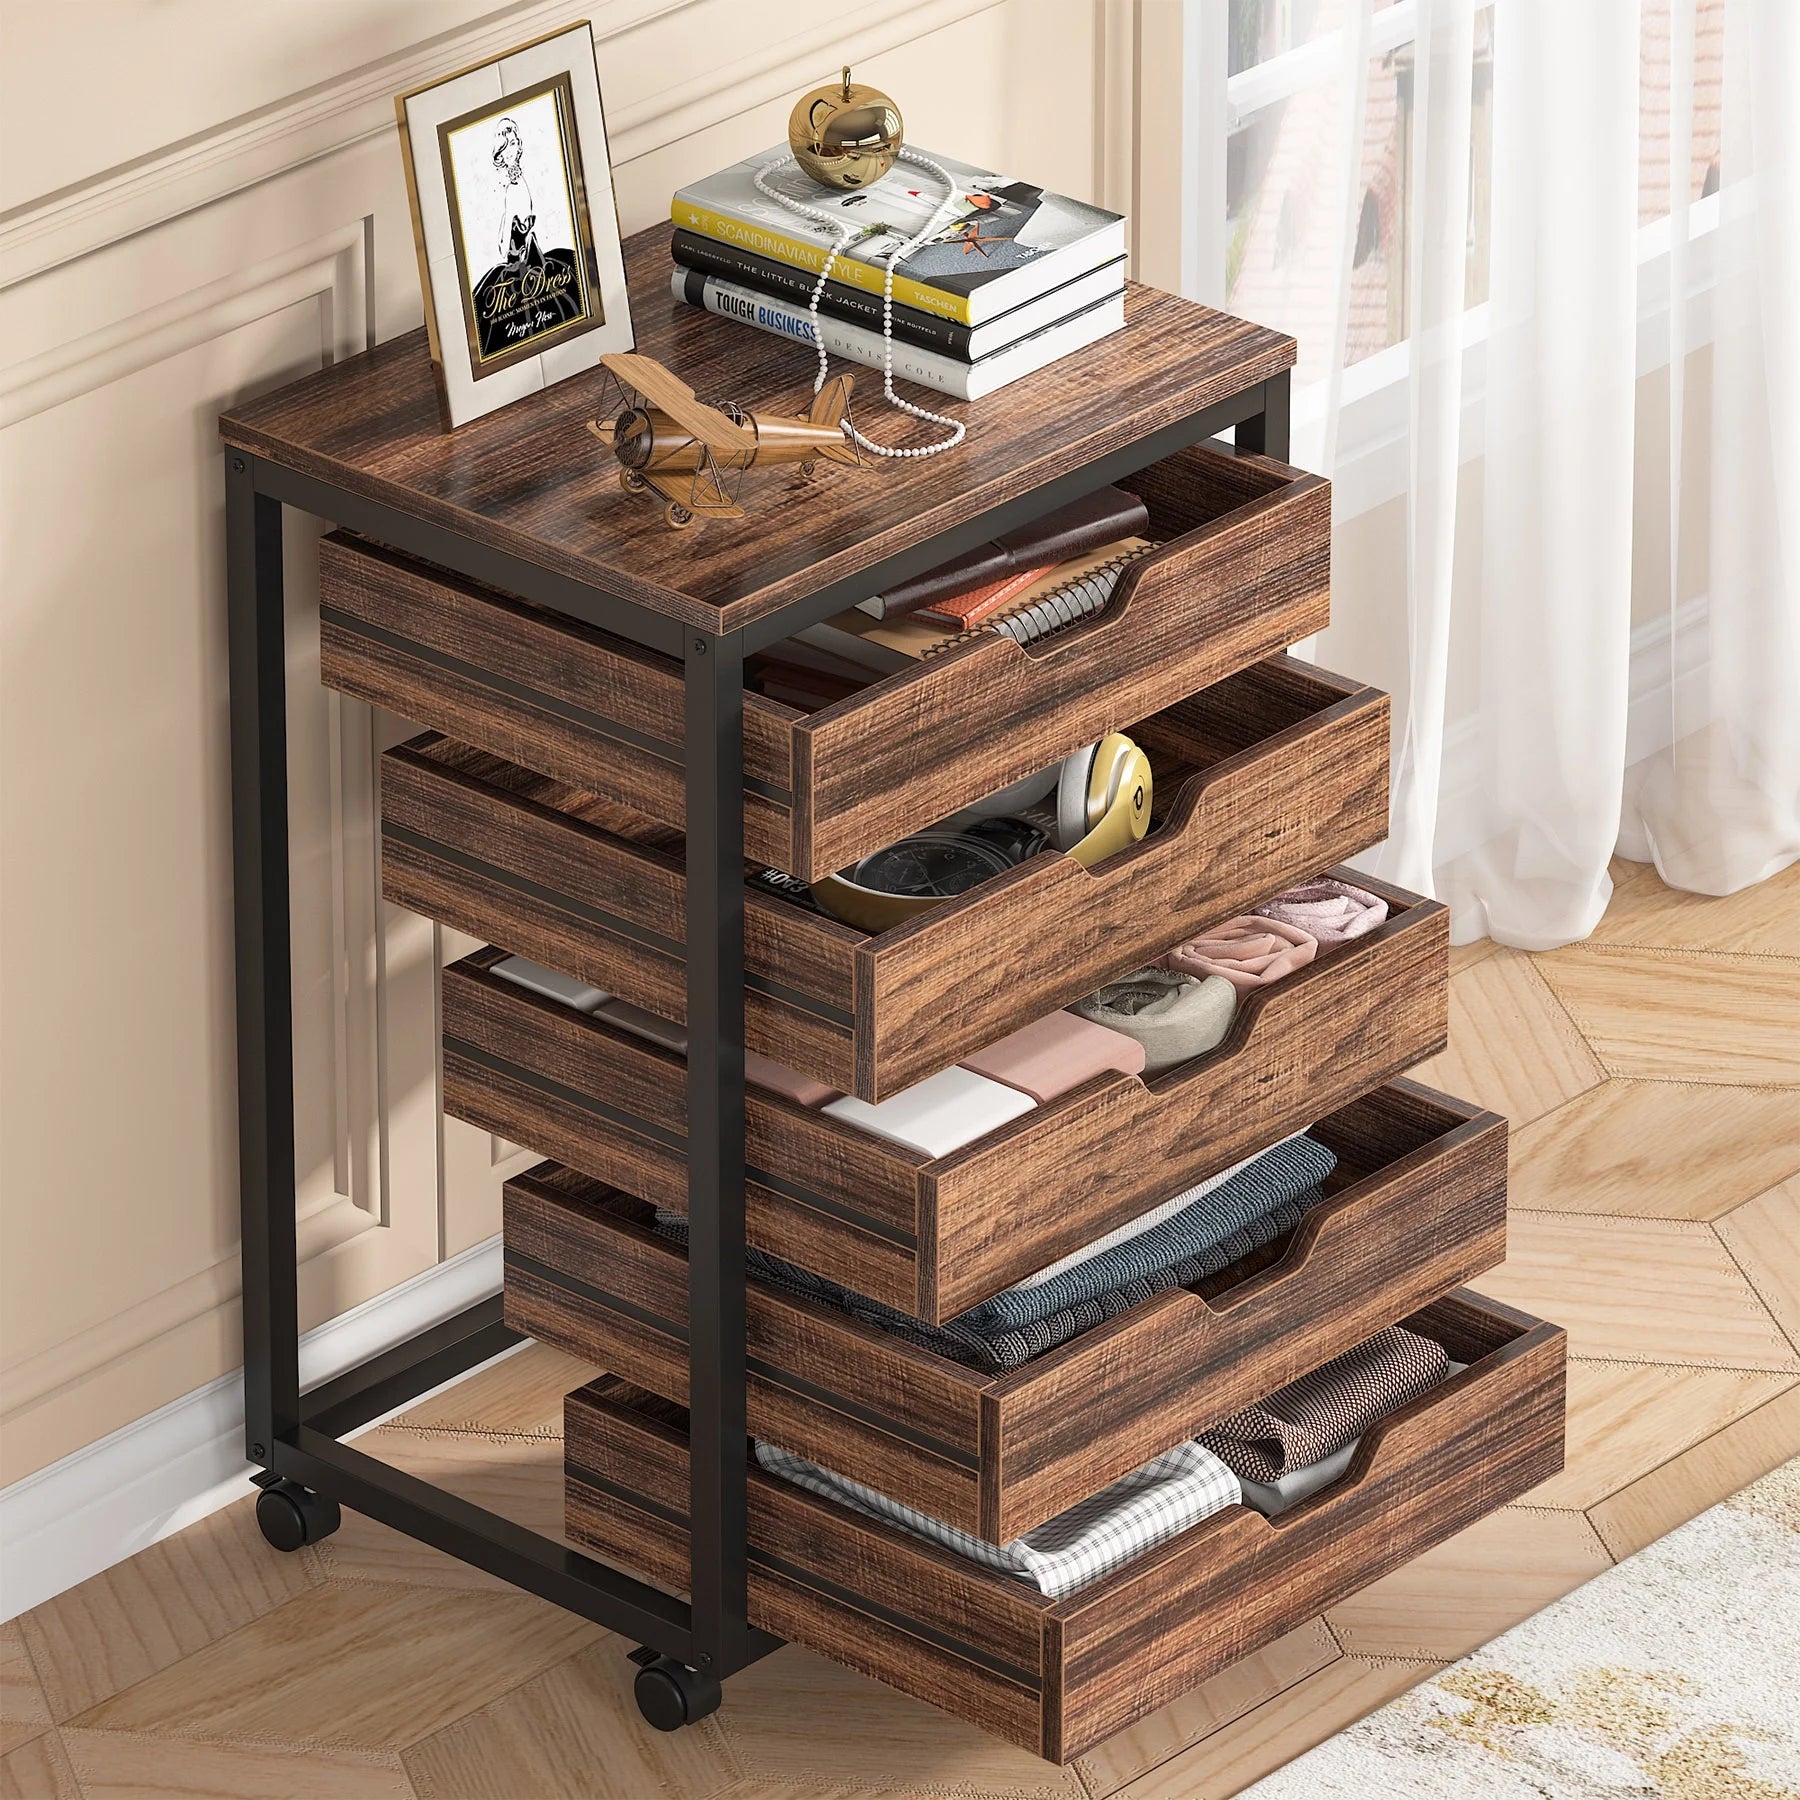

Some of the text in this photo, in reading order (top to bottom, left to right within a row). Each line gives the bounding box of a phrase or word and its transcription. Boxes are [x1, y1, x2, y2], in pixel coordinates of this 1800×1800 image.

[716, 221, 818, 267] SCANDINAVIAN
[822, 256, 864, 283] TYLE
[482, 262, 572, 319] The Dress
[680, 243, 696, 253] KARL
[697, 249, 731, 264] LAGERFELD
[737, 261, 758, 274] THE
[761, 270, 795, 287] LITTLE
[836, 295, 878, 315] JACKET
[906, 321, 937, 335] ROITFELD
[715, 291, 755, 321] TOUGH
[914, 291, 958, 314] TASCHEN
[834, 338, 945, 384] DENIS COLE
